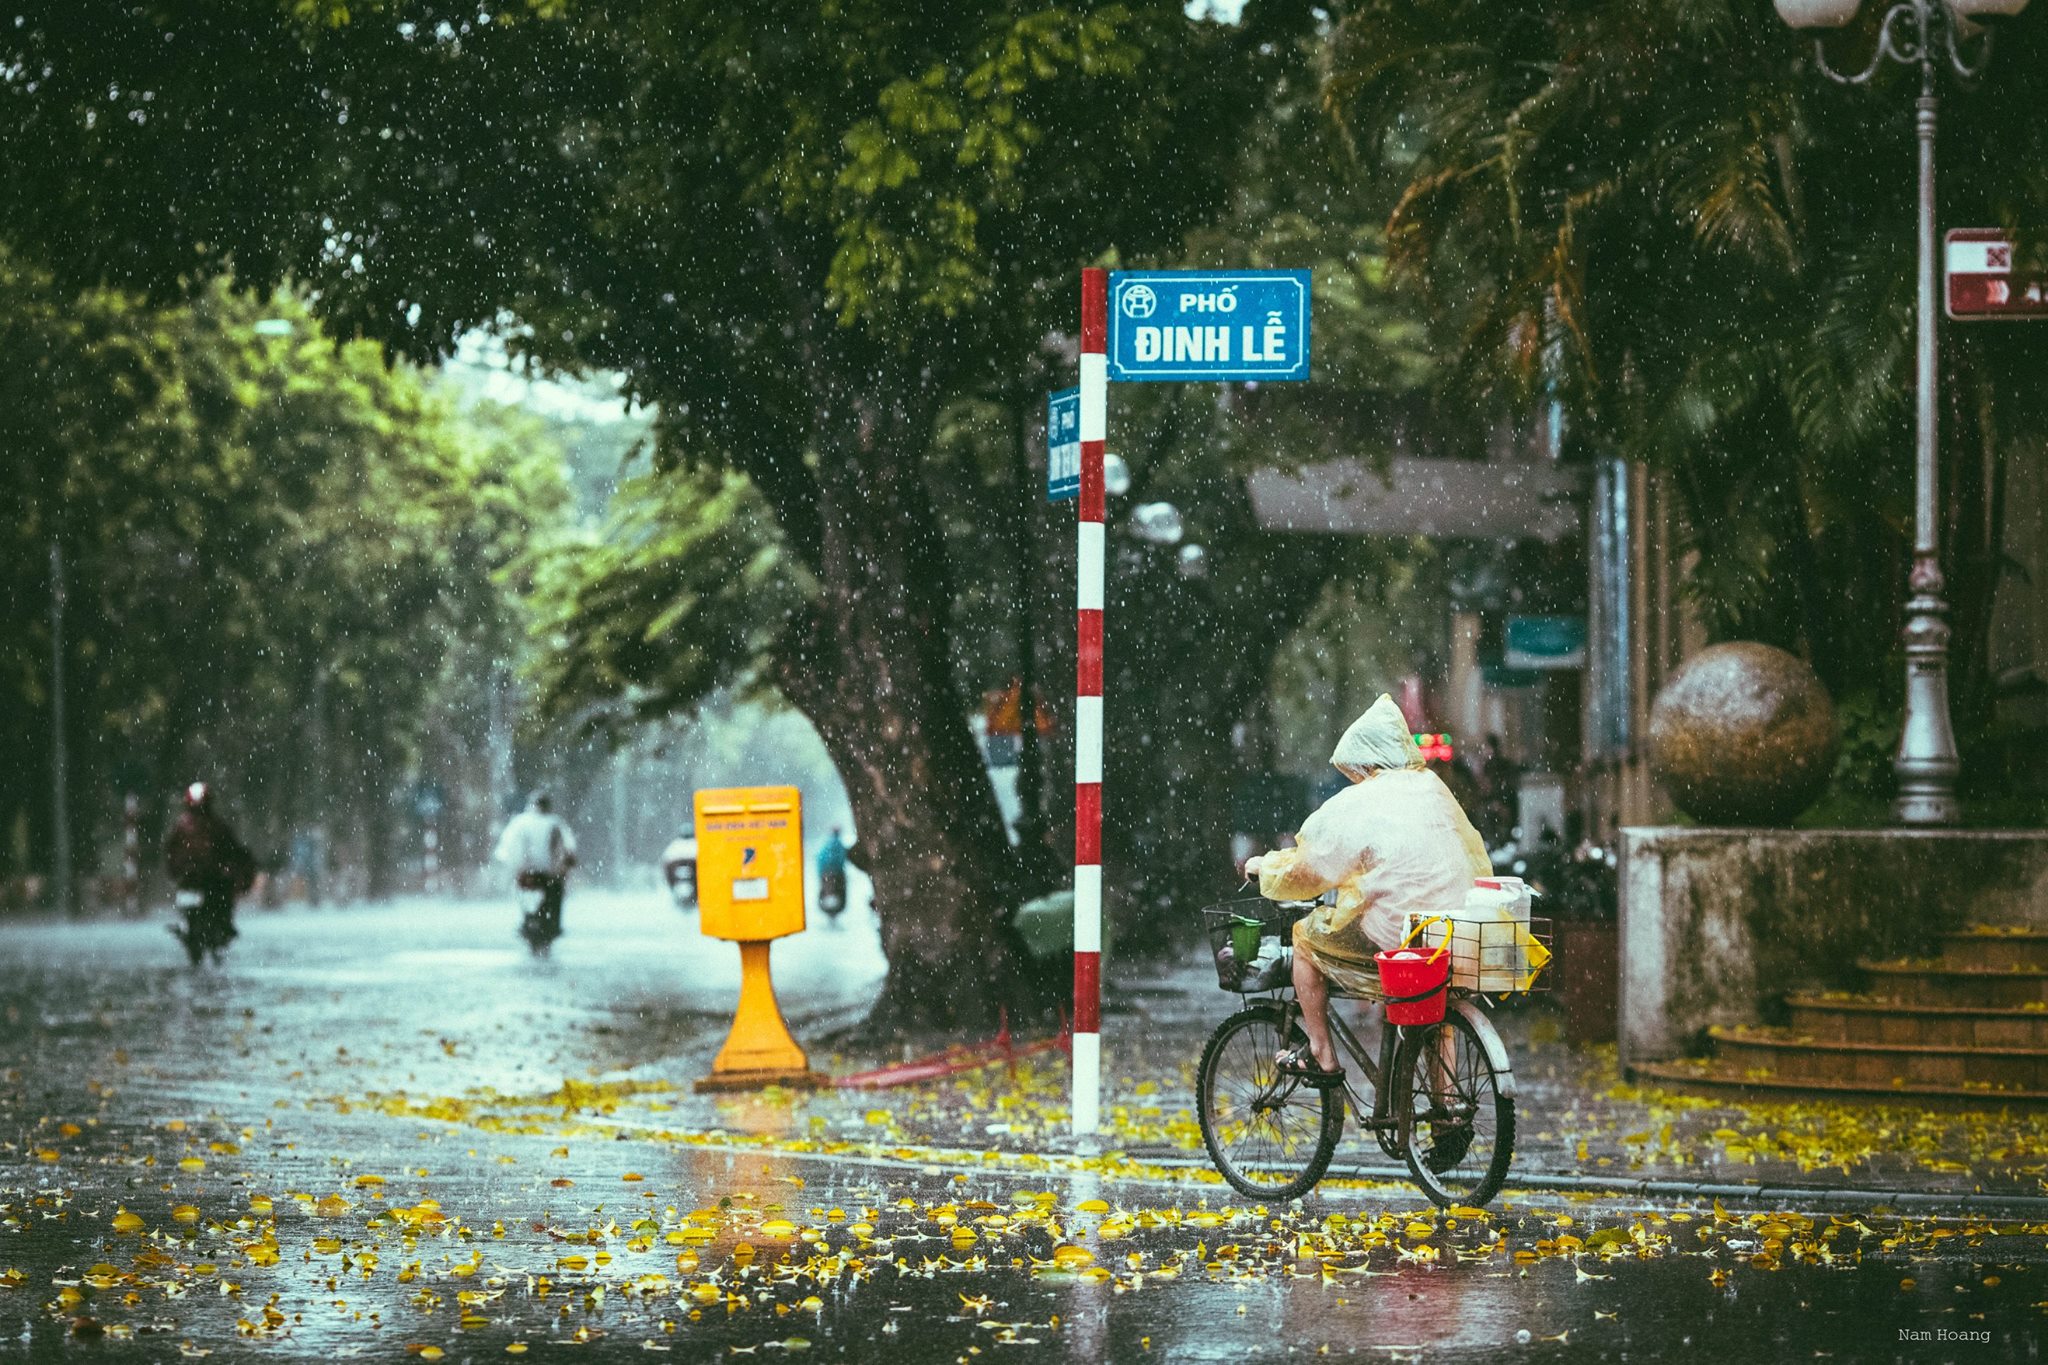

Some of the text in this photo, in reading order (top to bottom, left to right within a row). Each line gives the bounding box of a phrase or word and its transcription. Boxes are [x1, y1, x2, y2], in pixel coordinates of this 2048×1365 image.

[1181, 285, 1238, 312] PHỐ
[1134, 311, 1286, 362] ĐINH LỄ
